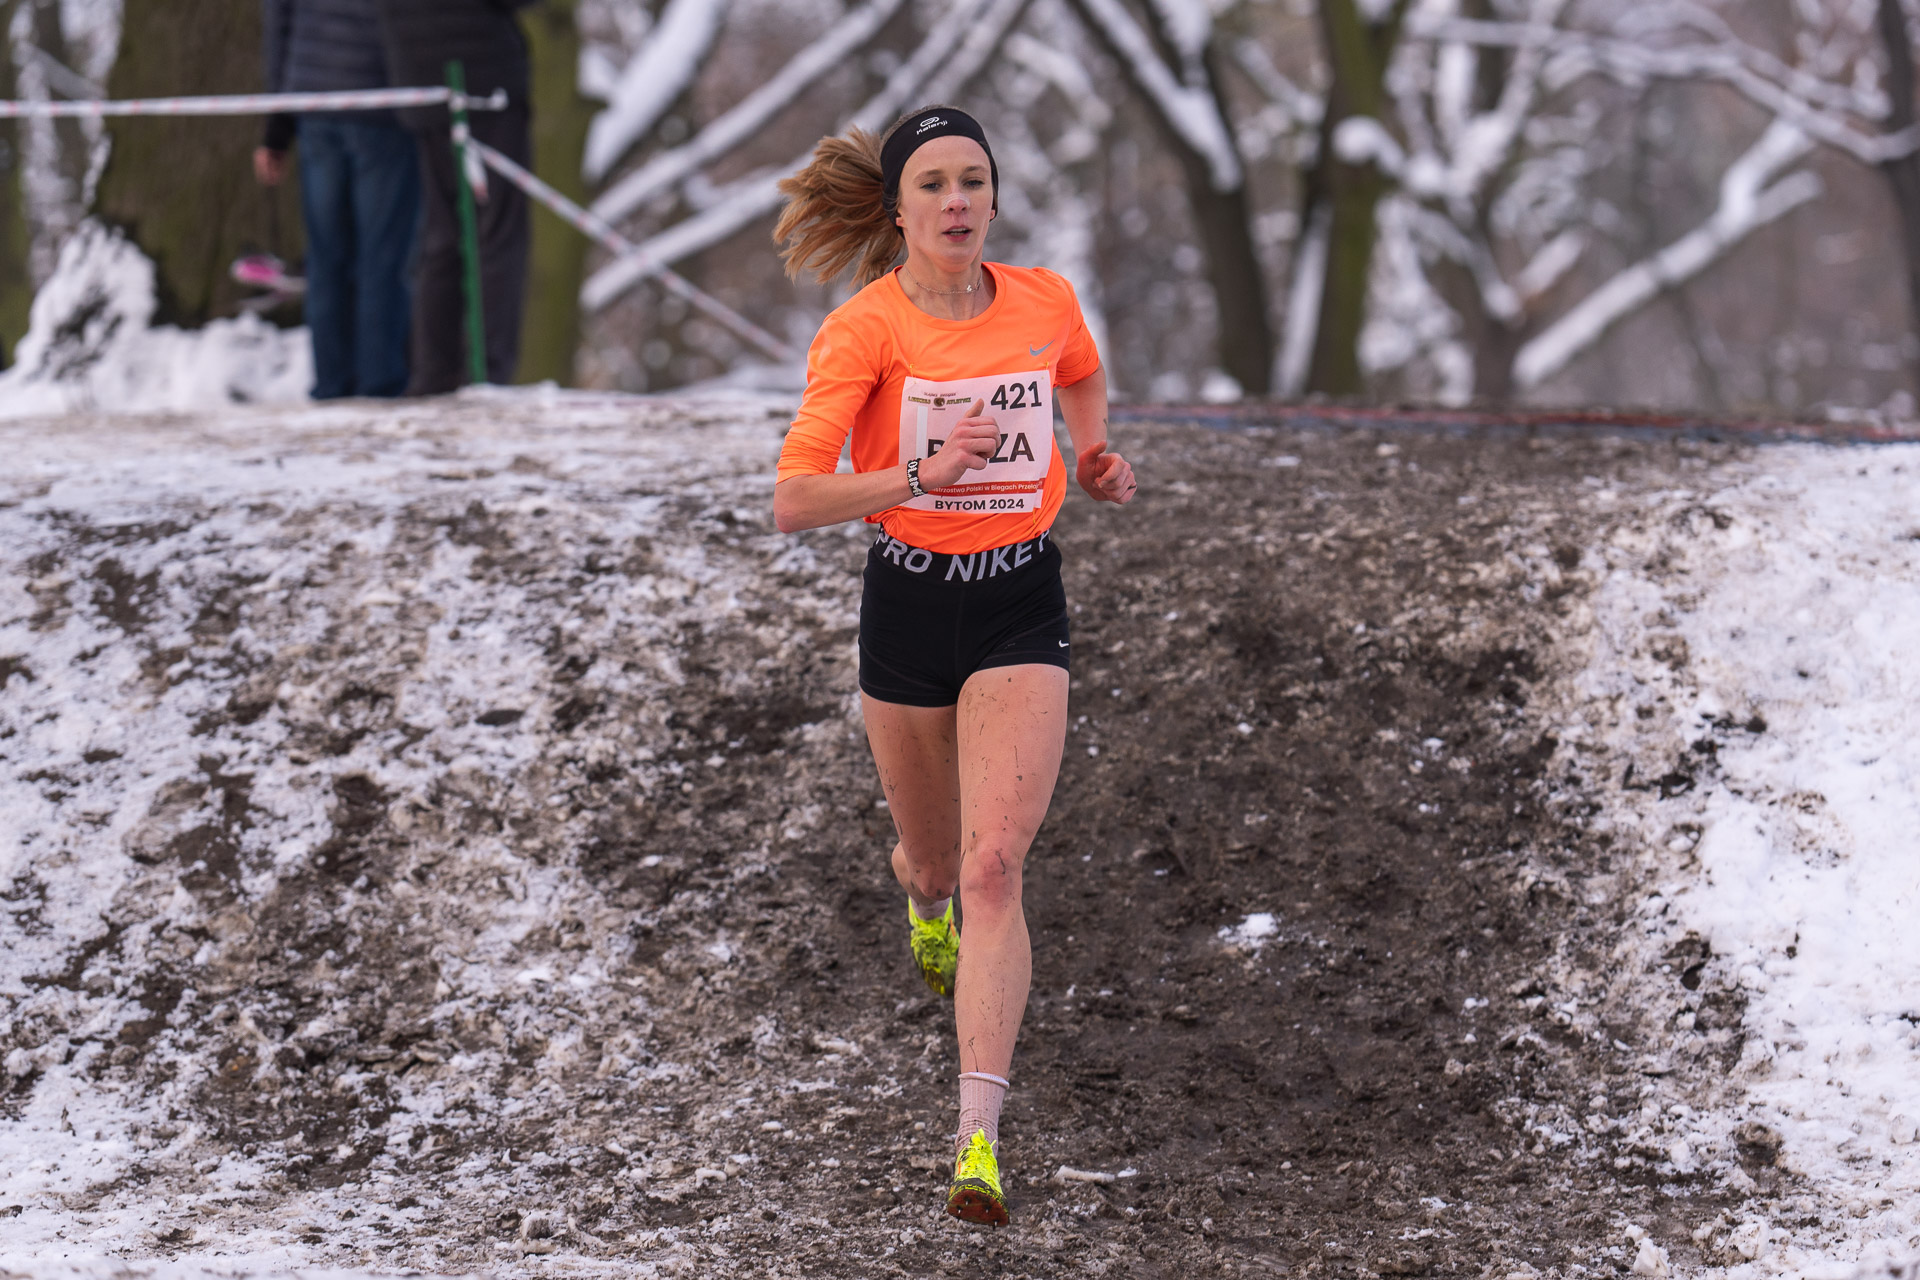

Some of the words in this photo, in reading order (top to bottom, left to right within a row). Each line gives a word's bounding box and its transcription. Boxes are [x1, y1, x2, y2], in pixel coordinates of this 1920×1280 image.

[991, 381, 1042, 410] 421
[932, 486, 966, 494] strzostwa
[966, 484, 984, 492] Polski
[935, 500, 986, 511] BYTOM
[989, 498, 1024, 510] 2024
[944, 541, 1033, 582] NIKE
